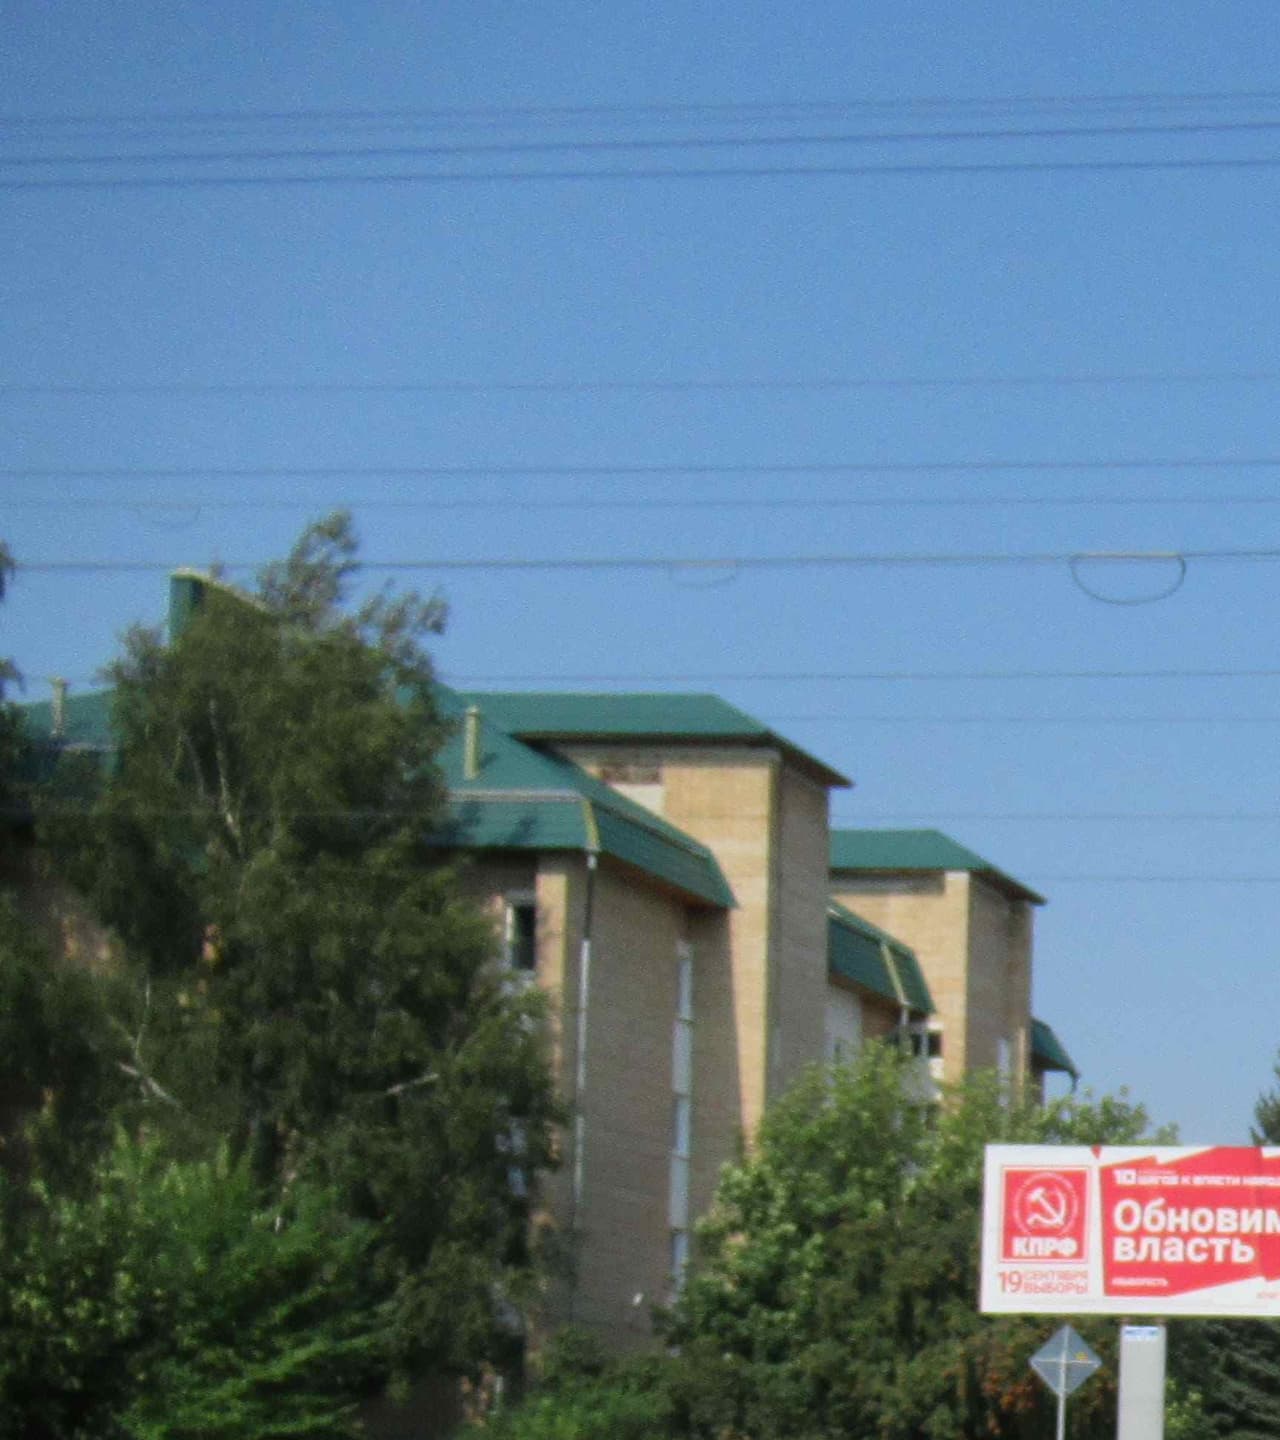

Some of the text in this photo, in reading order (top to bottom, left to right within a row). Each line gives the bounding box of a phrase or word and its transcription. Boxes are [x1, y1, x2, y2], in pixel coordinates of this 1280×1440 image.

[1012, 1237, 1079, 1258] КПРФ
[1112, 1237, 1255, 1264] власть
[998, 1271, 1023, 1293] 19
[1024, 1281, 1089, 1294] ВЫБОРЫ
